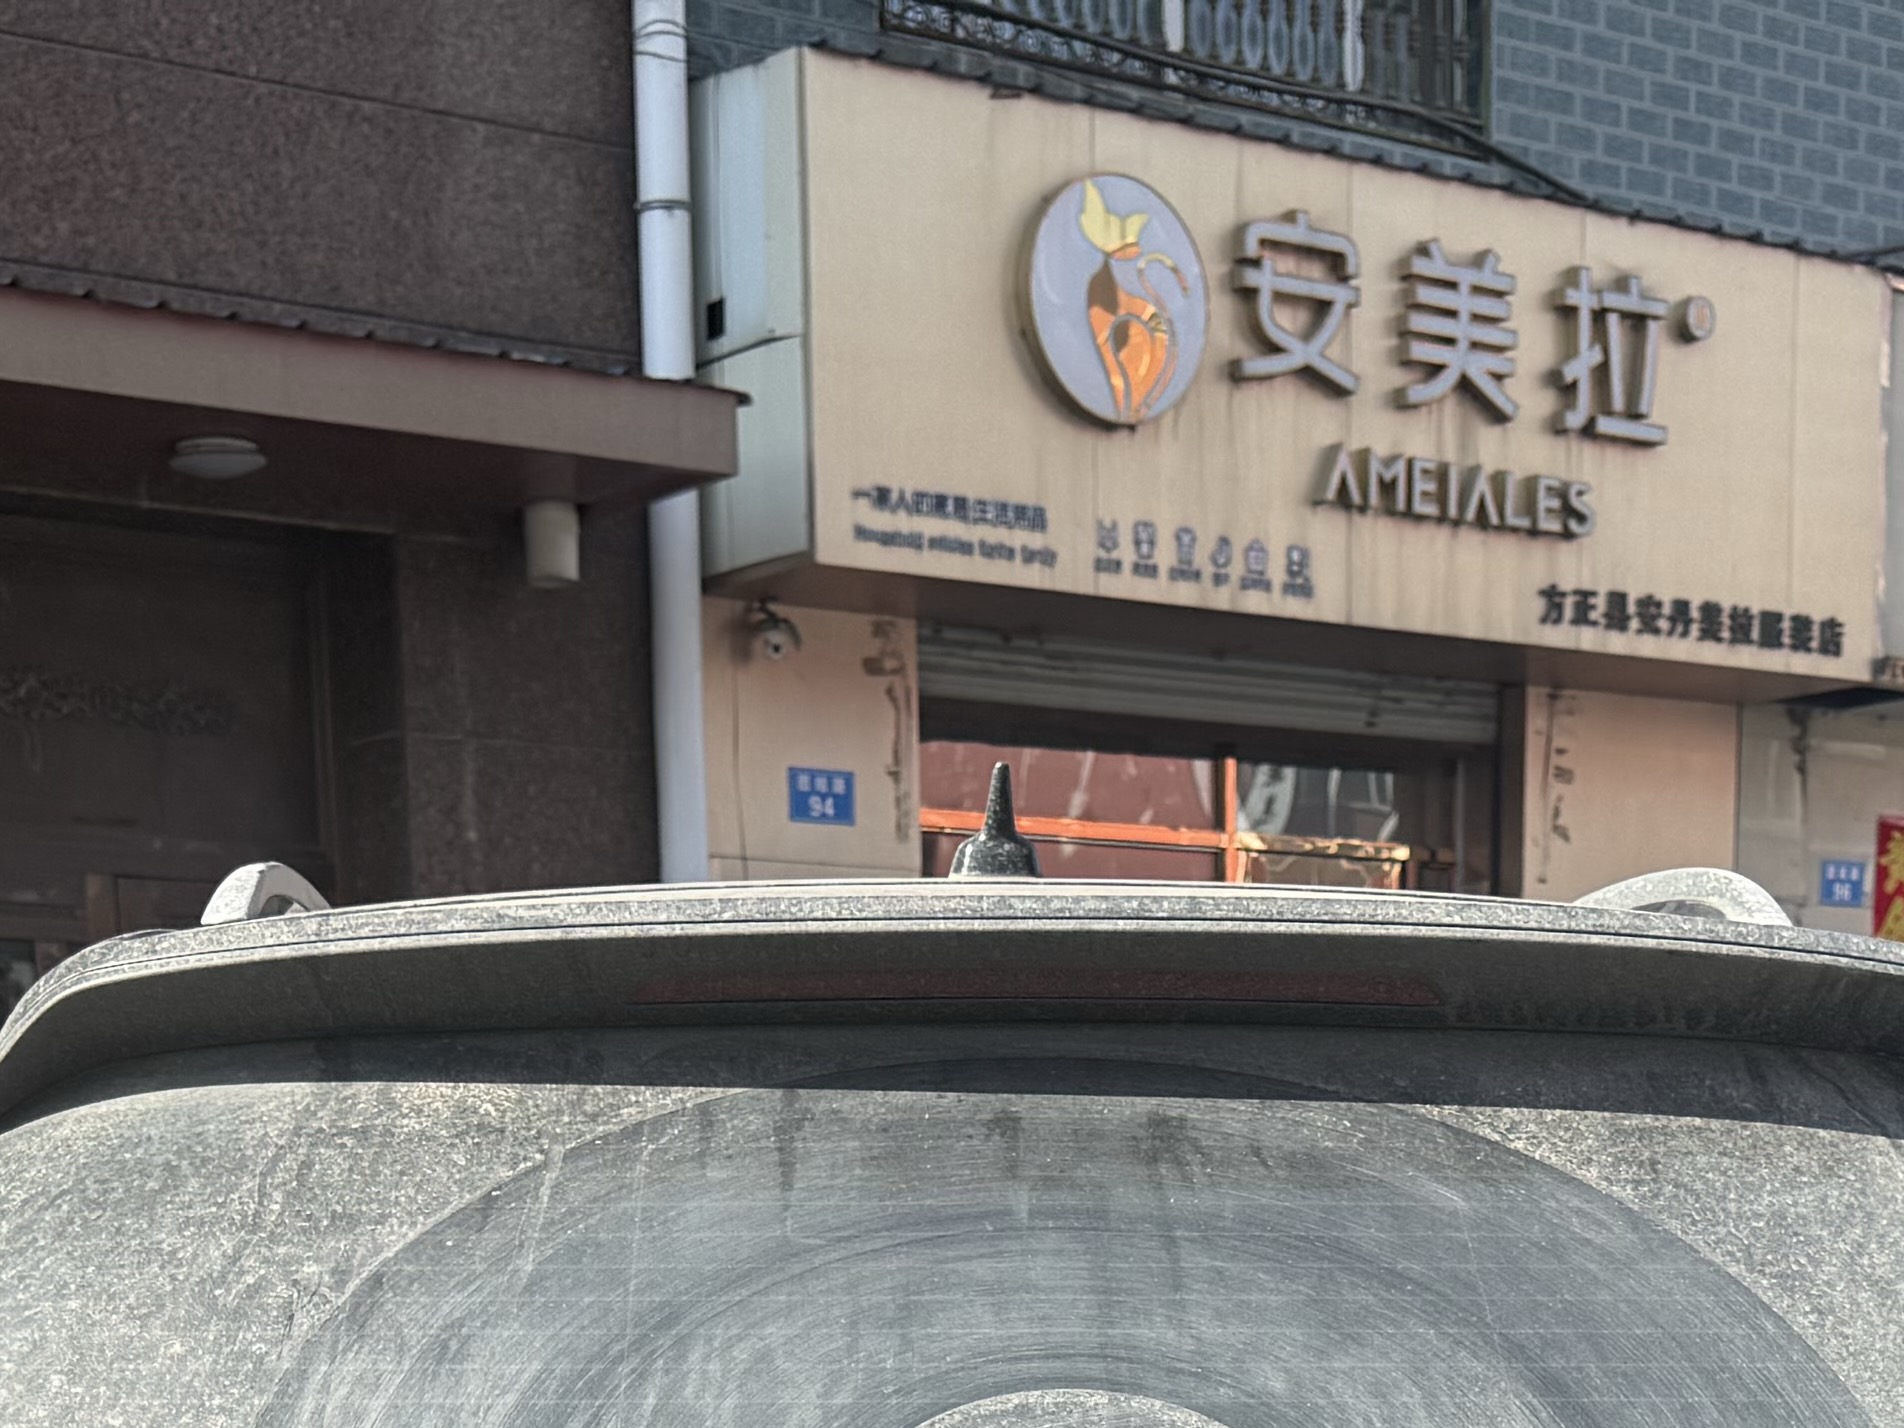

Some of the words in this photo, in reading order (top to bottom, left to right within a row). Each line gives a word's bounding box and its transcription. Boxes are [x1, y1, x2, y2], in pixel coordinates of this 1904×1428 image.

[1233, 209, 1669, 446] 安美拉
[1318, 444, 1597, 539] AMEIALES
[808, 795, 835, 817] 94
